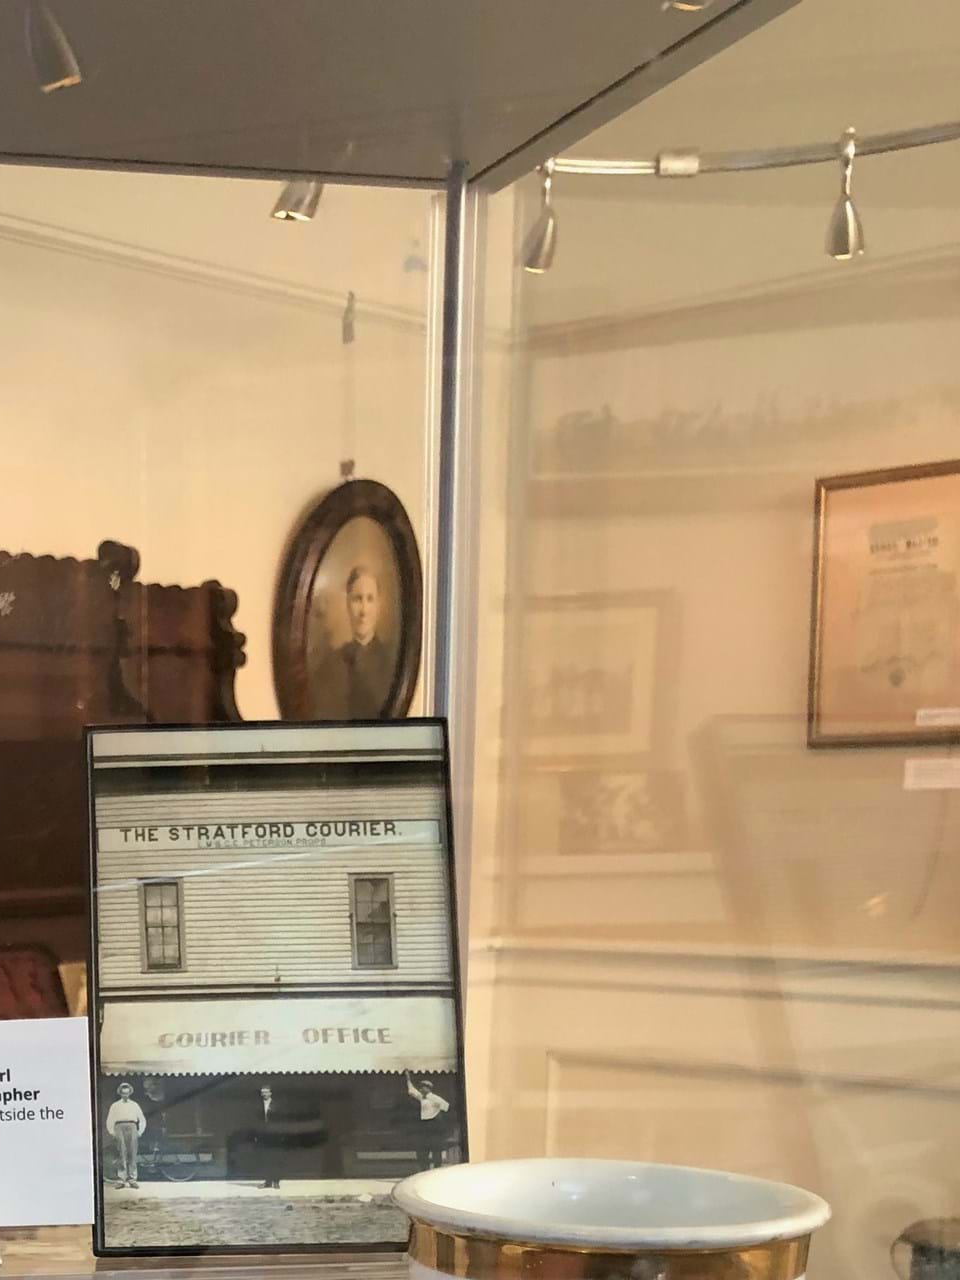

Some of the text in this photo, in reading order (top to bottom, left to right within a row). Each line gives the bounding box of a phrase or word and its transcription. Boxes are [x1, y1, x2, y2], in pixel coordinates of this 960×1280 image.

[120, 821, 403, 843] THE STRATFORD COURIER.
[158, 1027, 393, 1049] COURIER OFFICE
[39, 1106, 65, 1120] the
